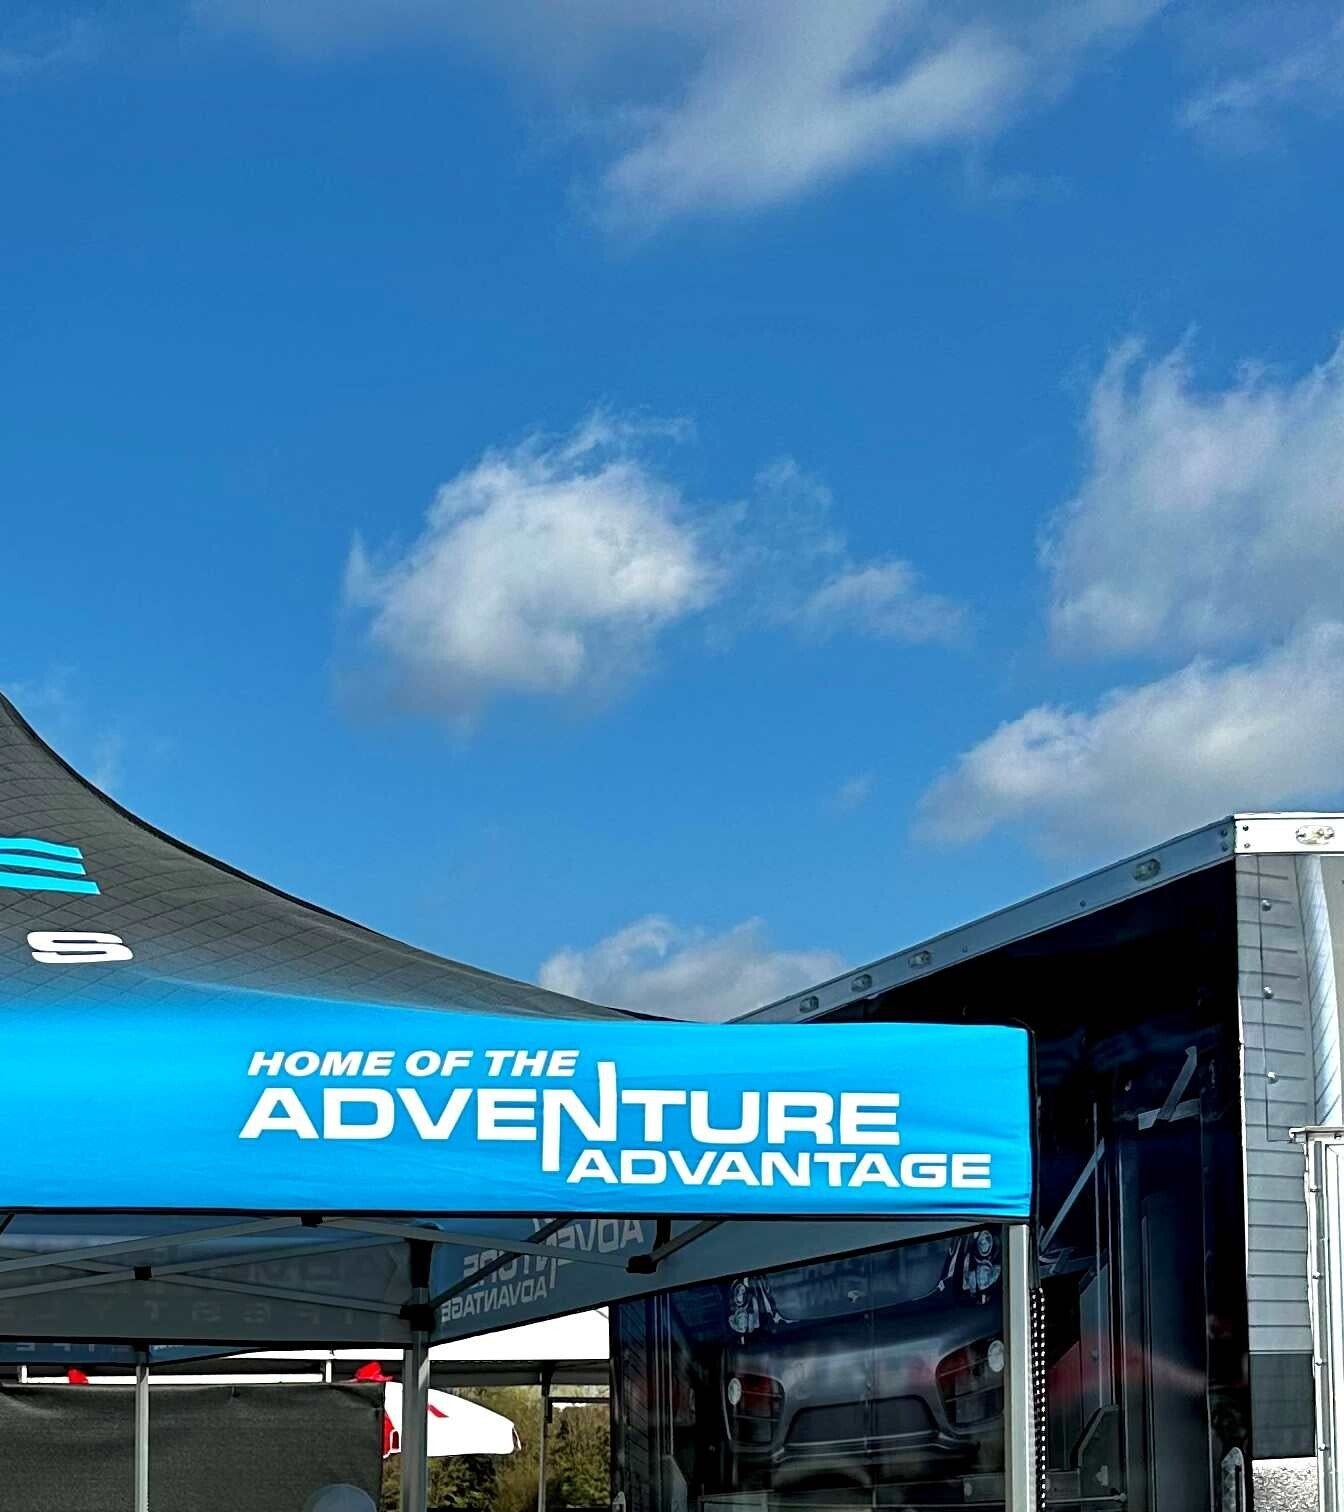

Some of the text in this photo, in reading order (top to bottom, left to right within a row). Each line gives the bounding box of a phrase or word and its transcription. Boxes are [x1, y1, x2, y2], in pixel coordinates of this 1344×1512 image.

[247, 1050, 581, 1077] HOME OF THE
[239, 1061, 901, 1172] ADVENTURE
[567, 1149, 992, 1189] ADVANTAGE
